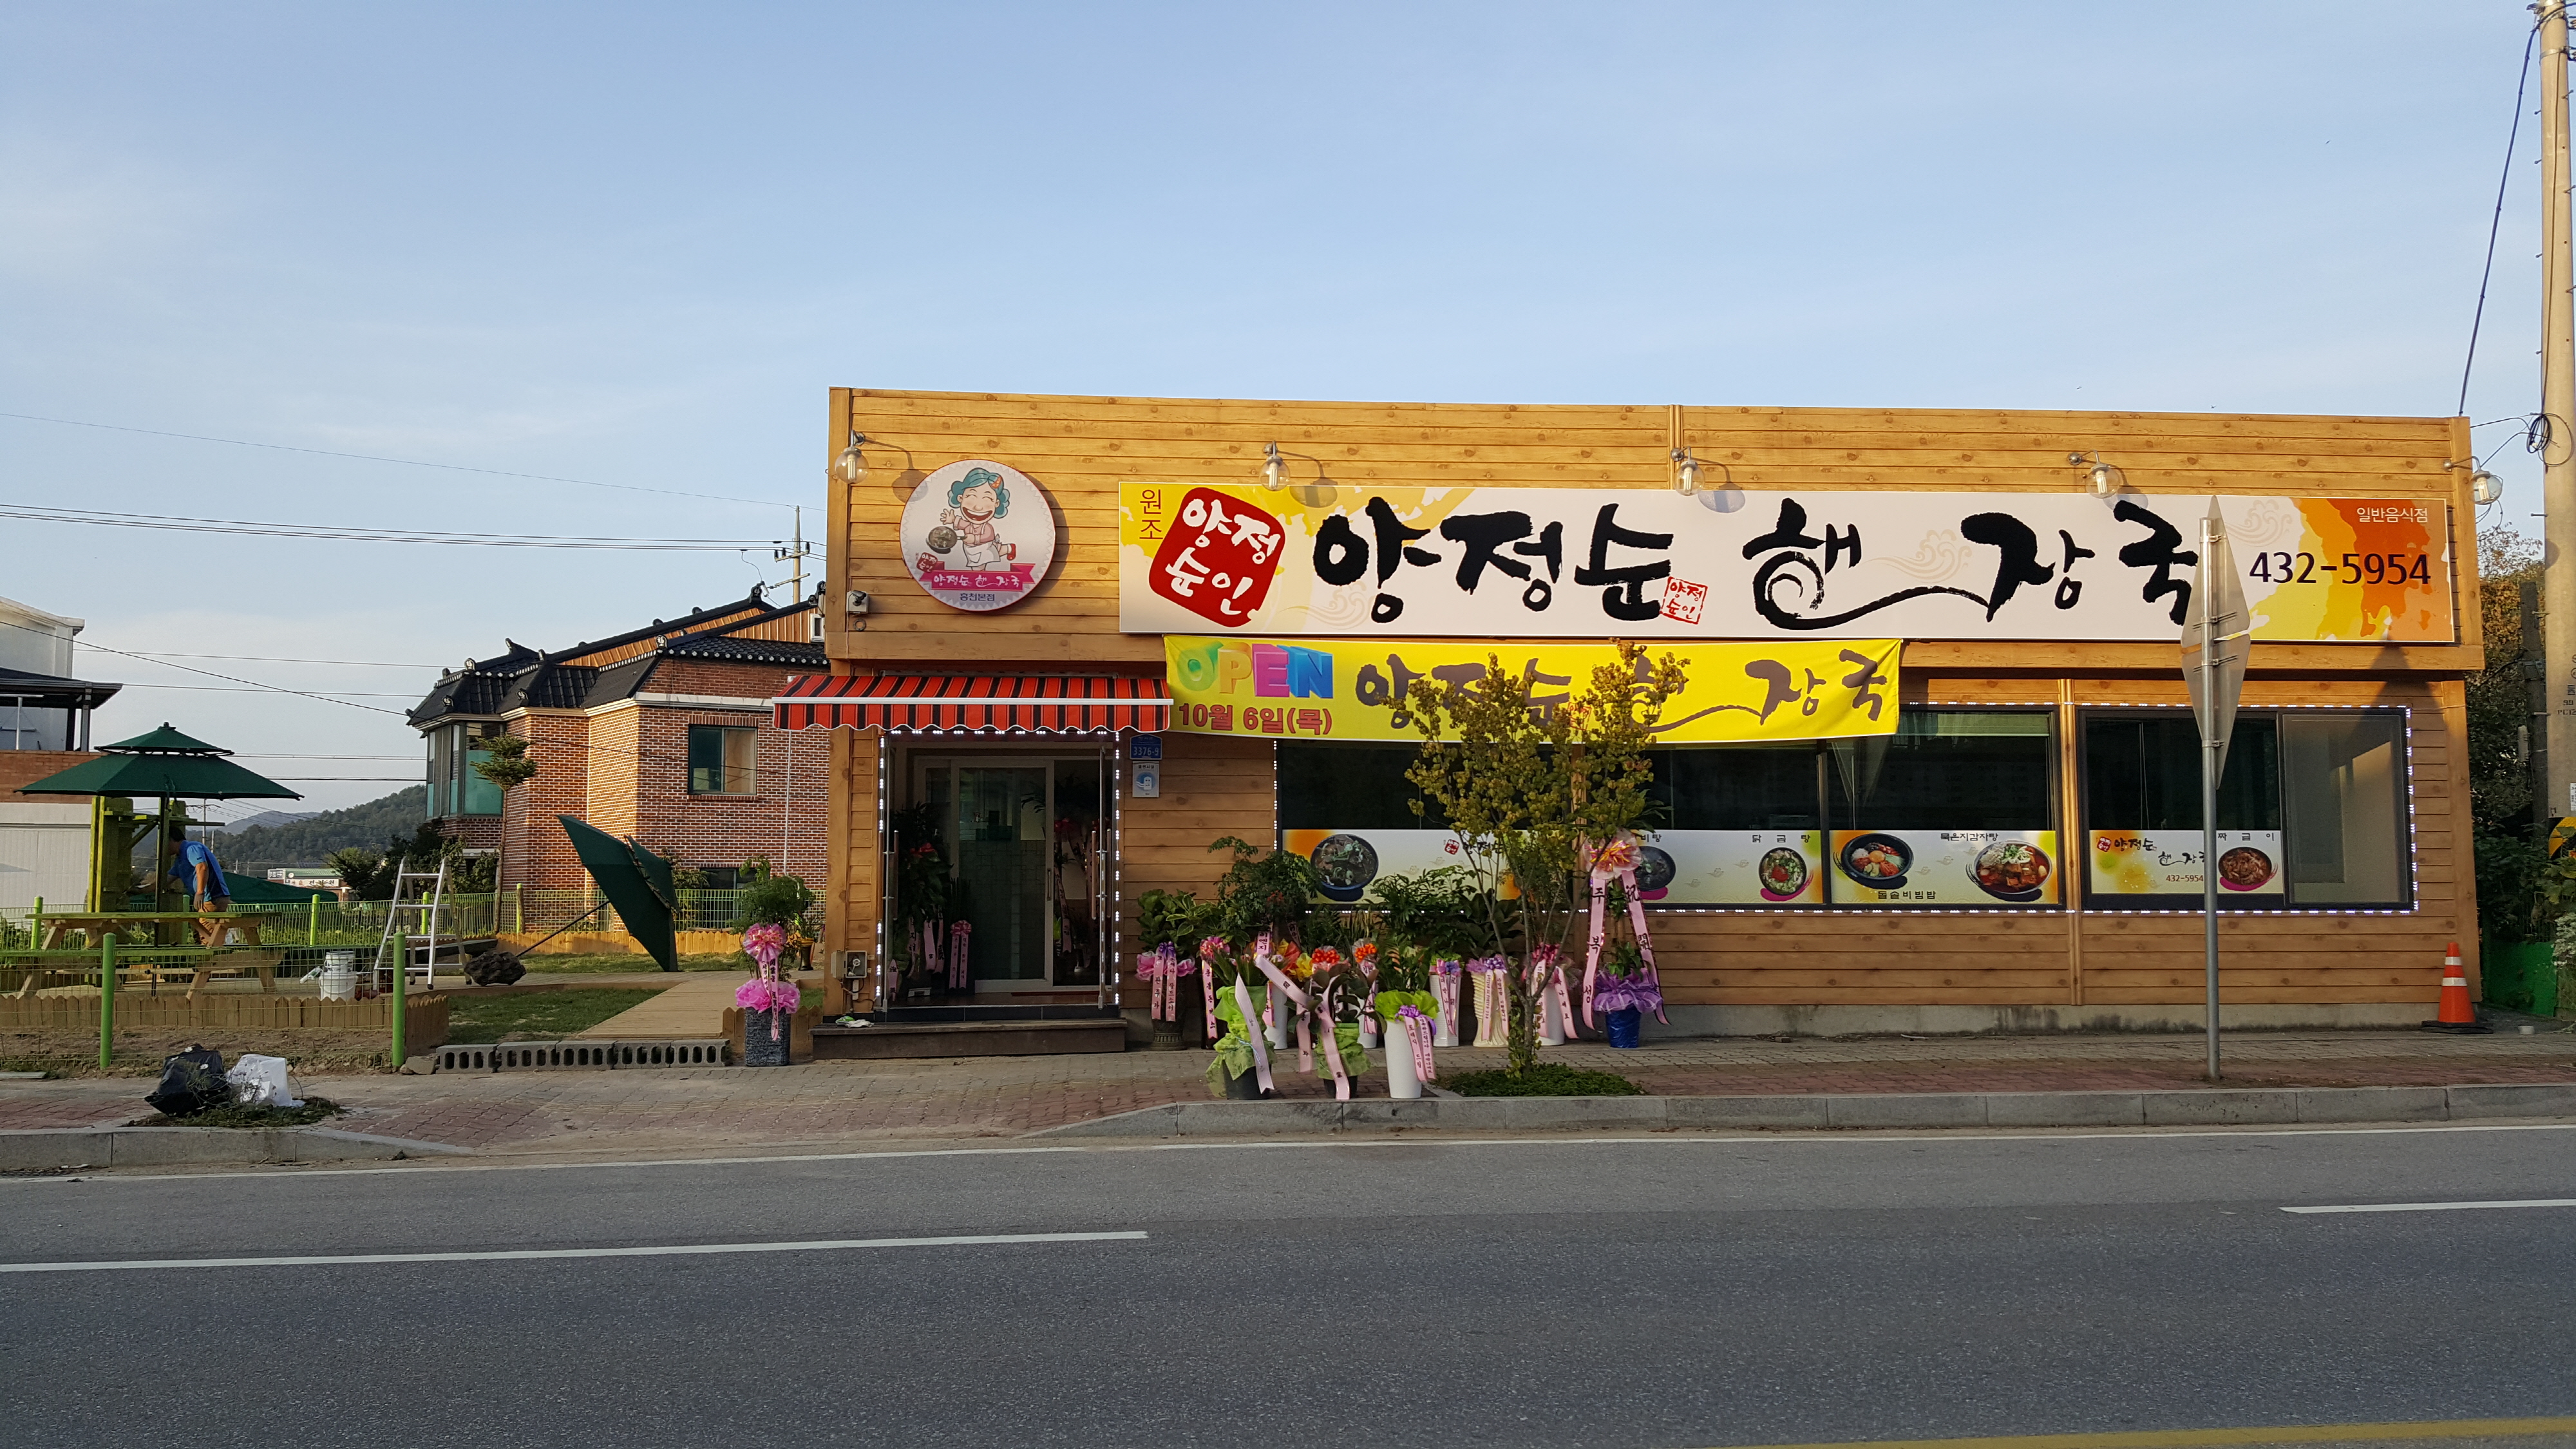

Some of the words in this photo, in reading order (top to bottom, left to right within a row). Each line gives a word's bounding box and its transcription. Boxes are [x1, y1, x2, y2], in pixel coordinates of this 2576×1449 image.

[1139, 489, 1164, 540] 원조
[2356, 507, 2429, 524] 일반음식점
[1182, 498, 1281, 565] 양정
[1312, 497, 1674, 623] 양정순
[2249, 551, 2432, 585] 432-5954
[933, 574, 969, 587] 양정순
[1165, 546, 1254, 616] 순인
[960, 592, 996, 601] 홍천본점
[1670, 582, 1703, 602] 양정
[1177, 641, 1334, 699] OPEN
[1179, 703, 1233, 731] 10월
[1243, 707, 1332, 735] 6일(목)
[1133, 747, 1159, 756] 3376-9
[1940, 832, 1998, 842] 묵은지감자탕
[2114, 837, 2154, 851] 양정순
[1877, 891, 1936, 900] 돌솥비빔밥
